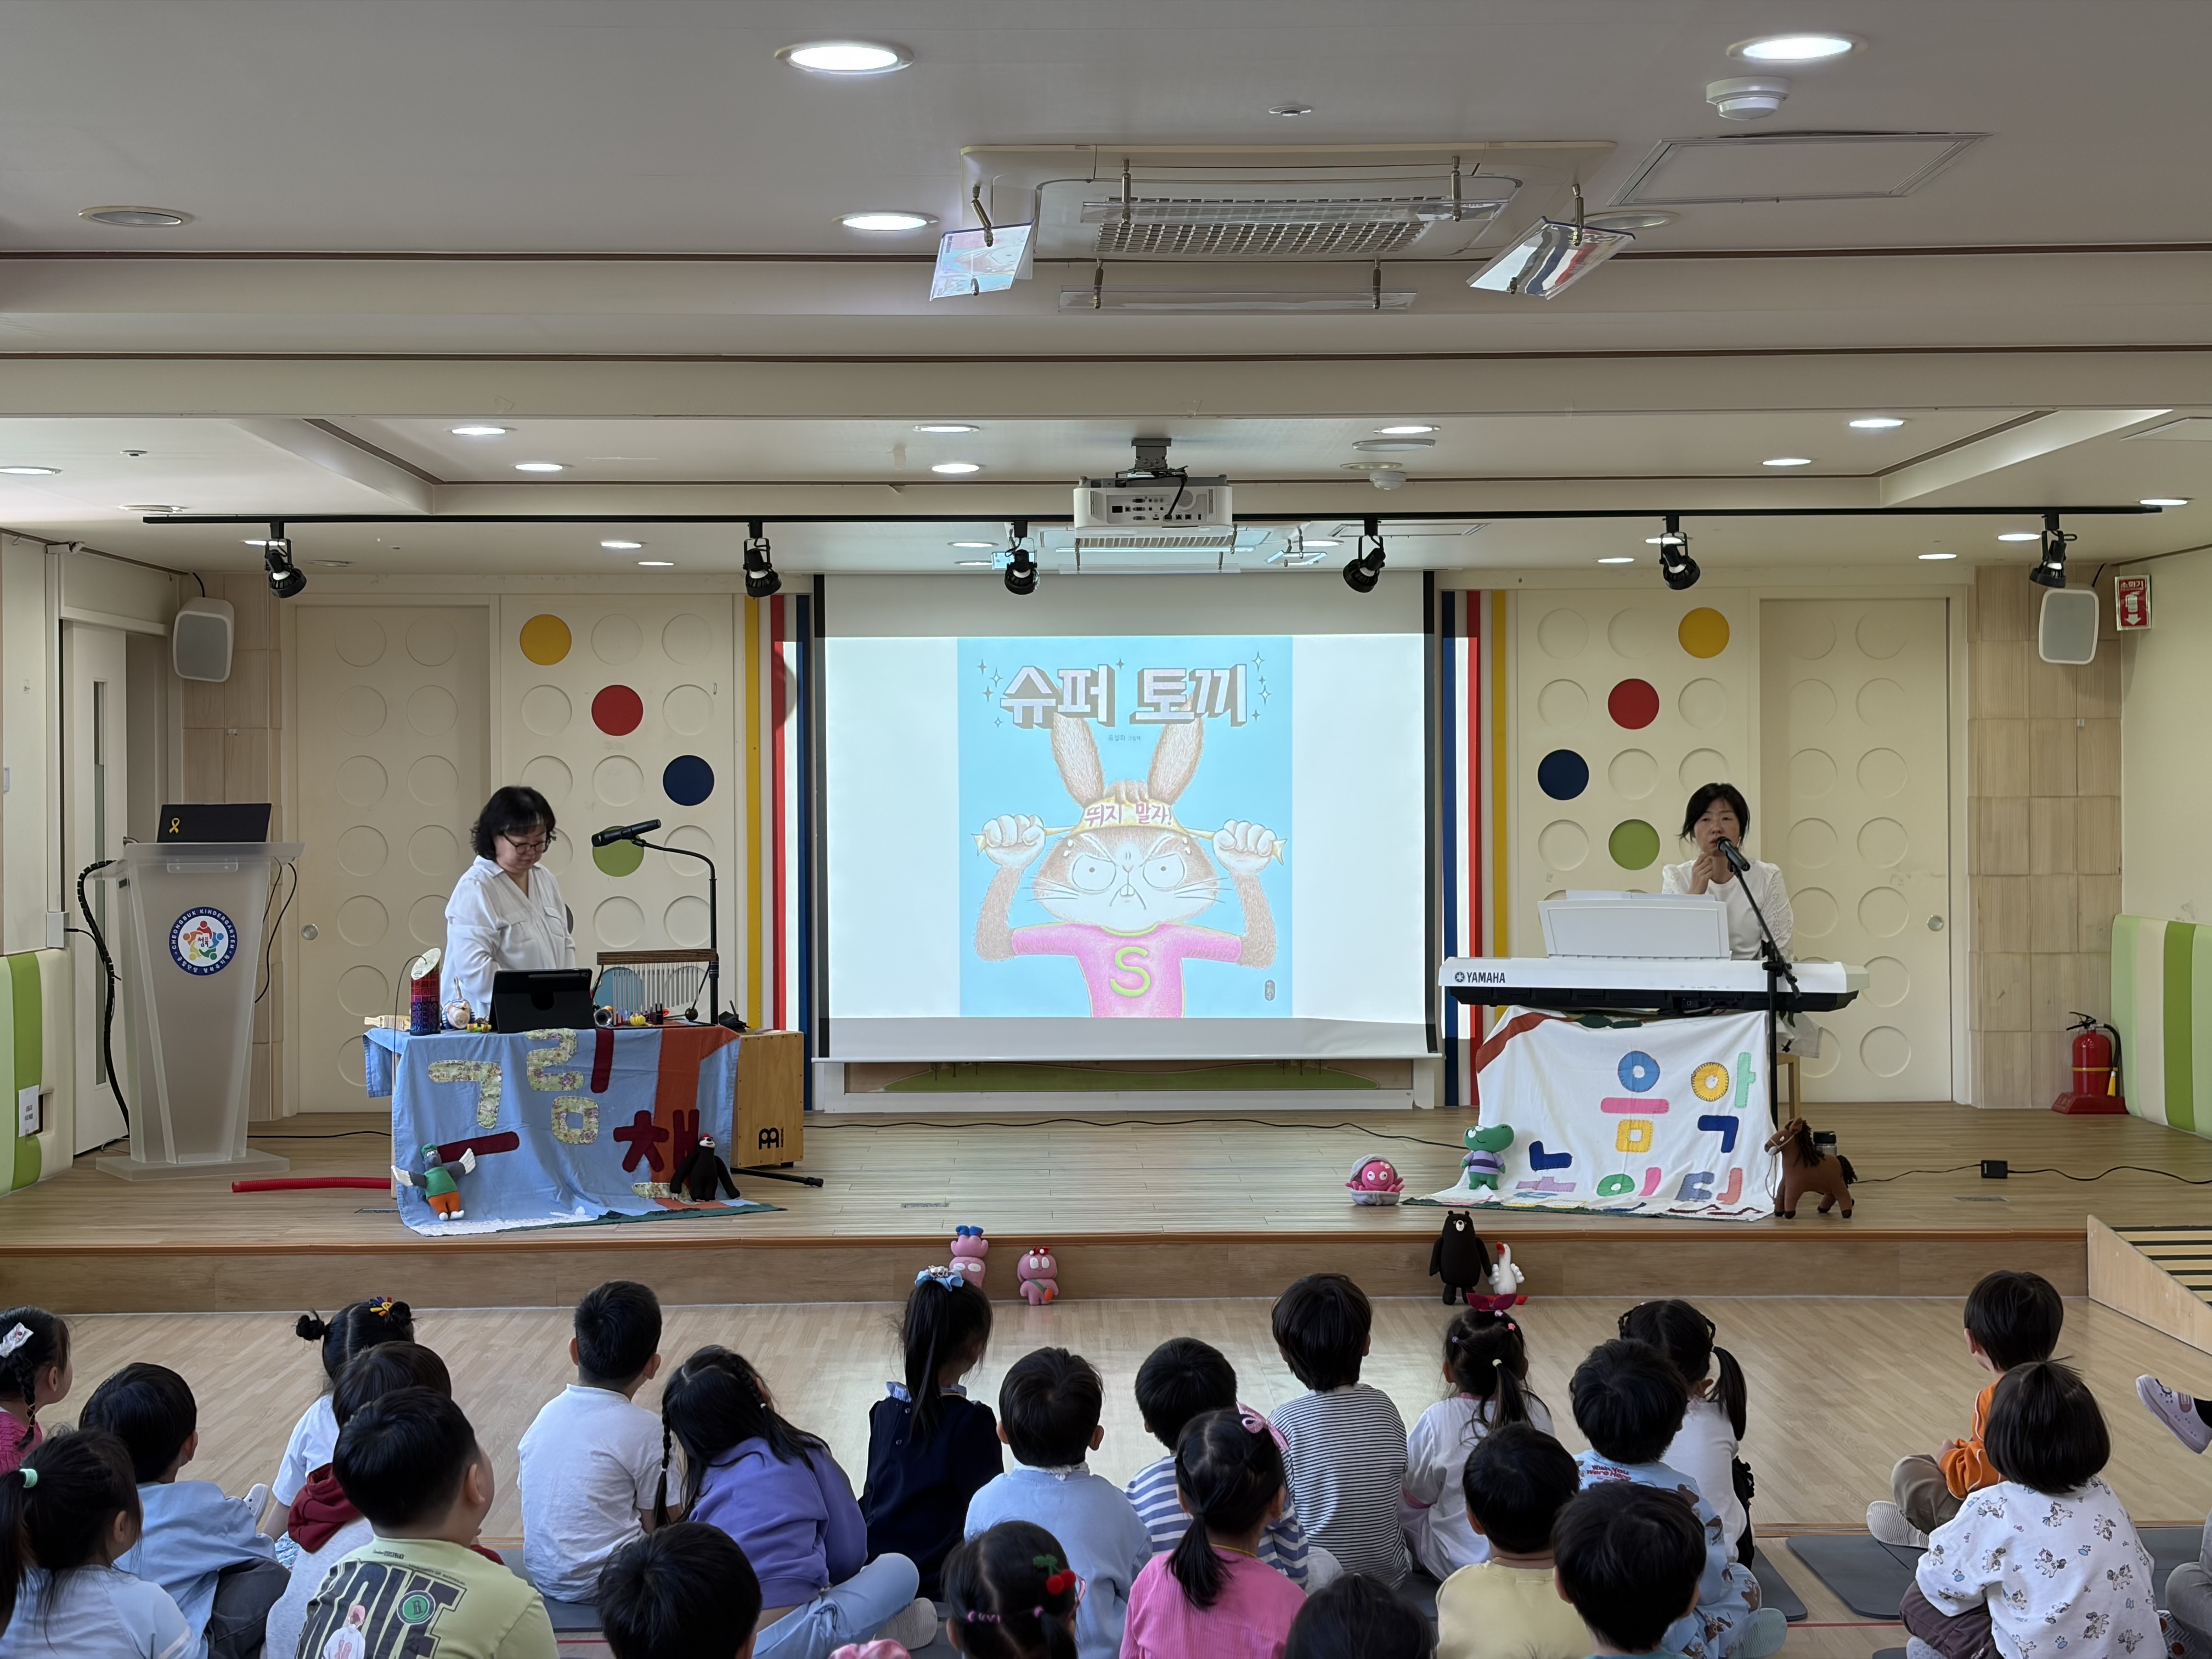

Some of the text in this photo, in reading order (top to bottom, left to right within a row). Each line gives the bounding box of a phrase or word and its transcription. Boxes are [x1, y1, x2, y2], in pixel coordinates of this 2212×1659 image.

[2121, 580, 2144, 591] 소화기
[1000, 664, 1247, 729] 슈퍼 토끼
[1084, 803, 1172, 827] 뛰지 말자!
[172, 909, 235, 950] CHEONGBUK KINDERGARTEN
[1110, 946, 1151, 997] S
[1466, 972, 1506, 984] YAMAHA
[1600, 1051, 1756, 1154] 음악
